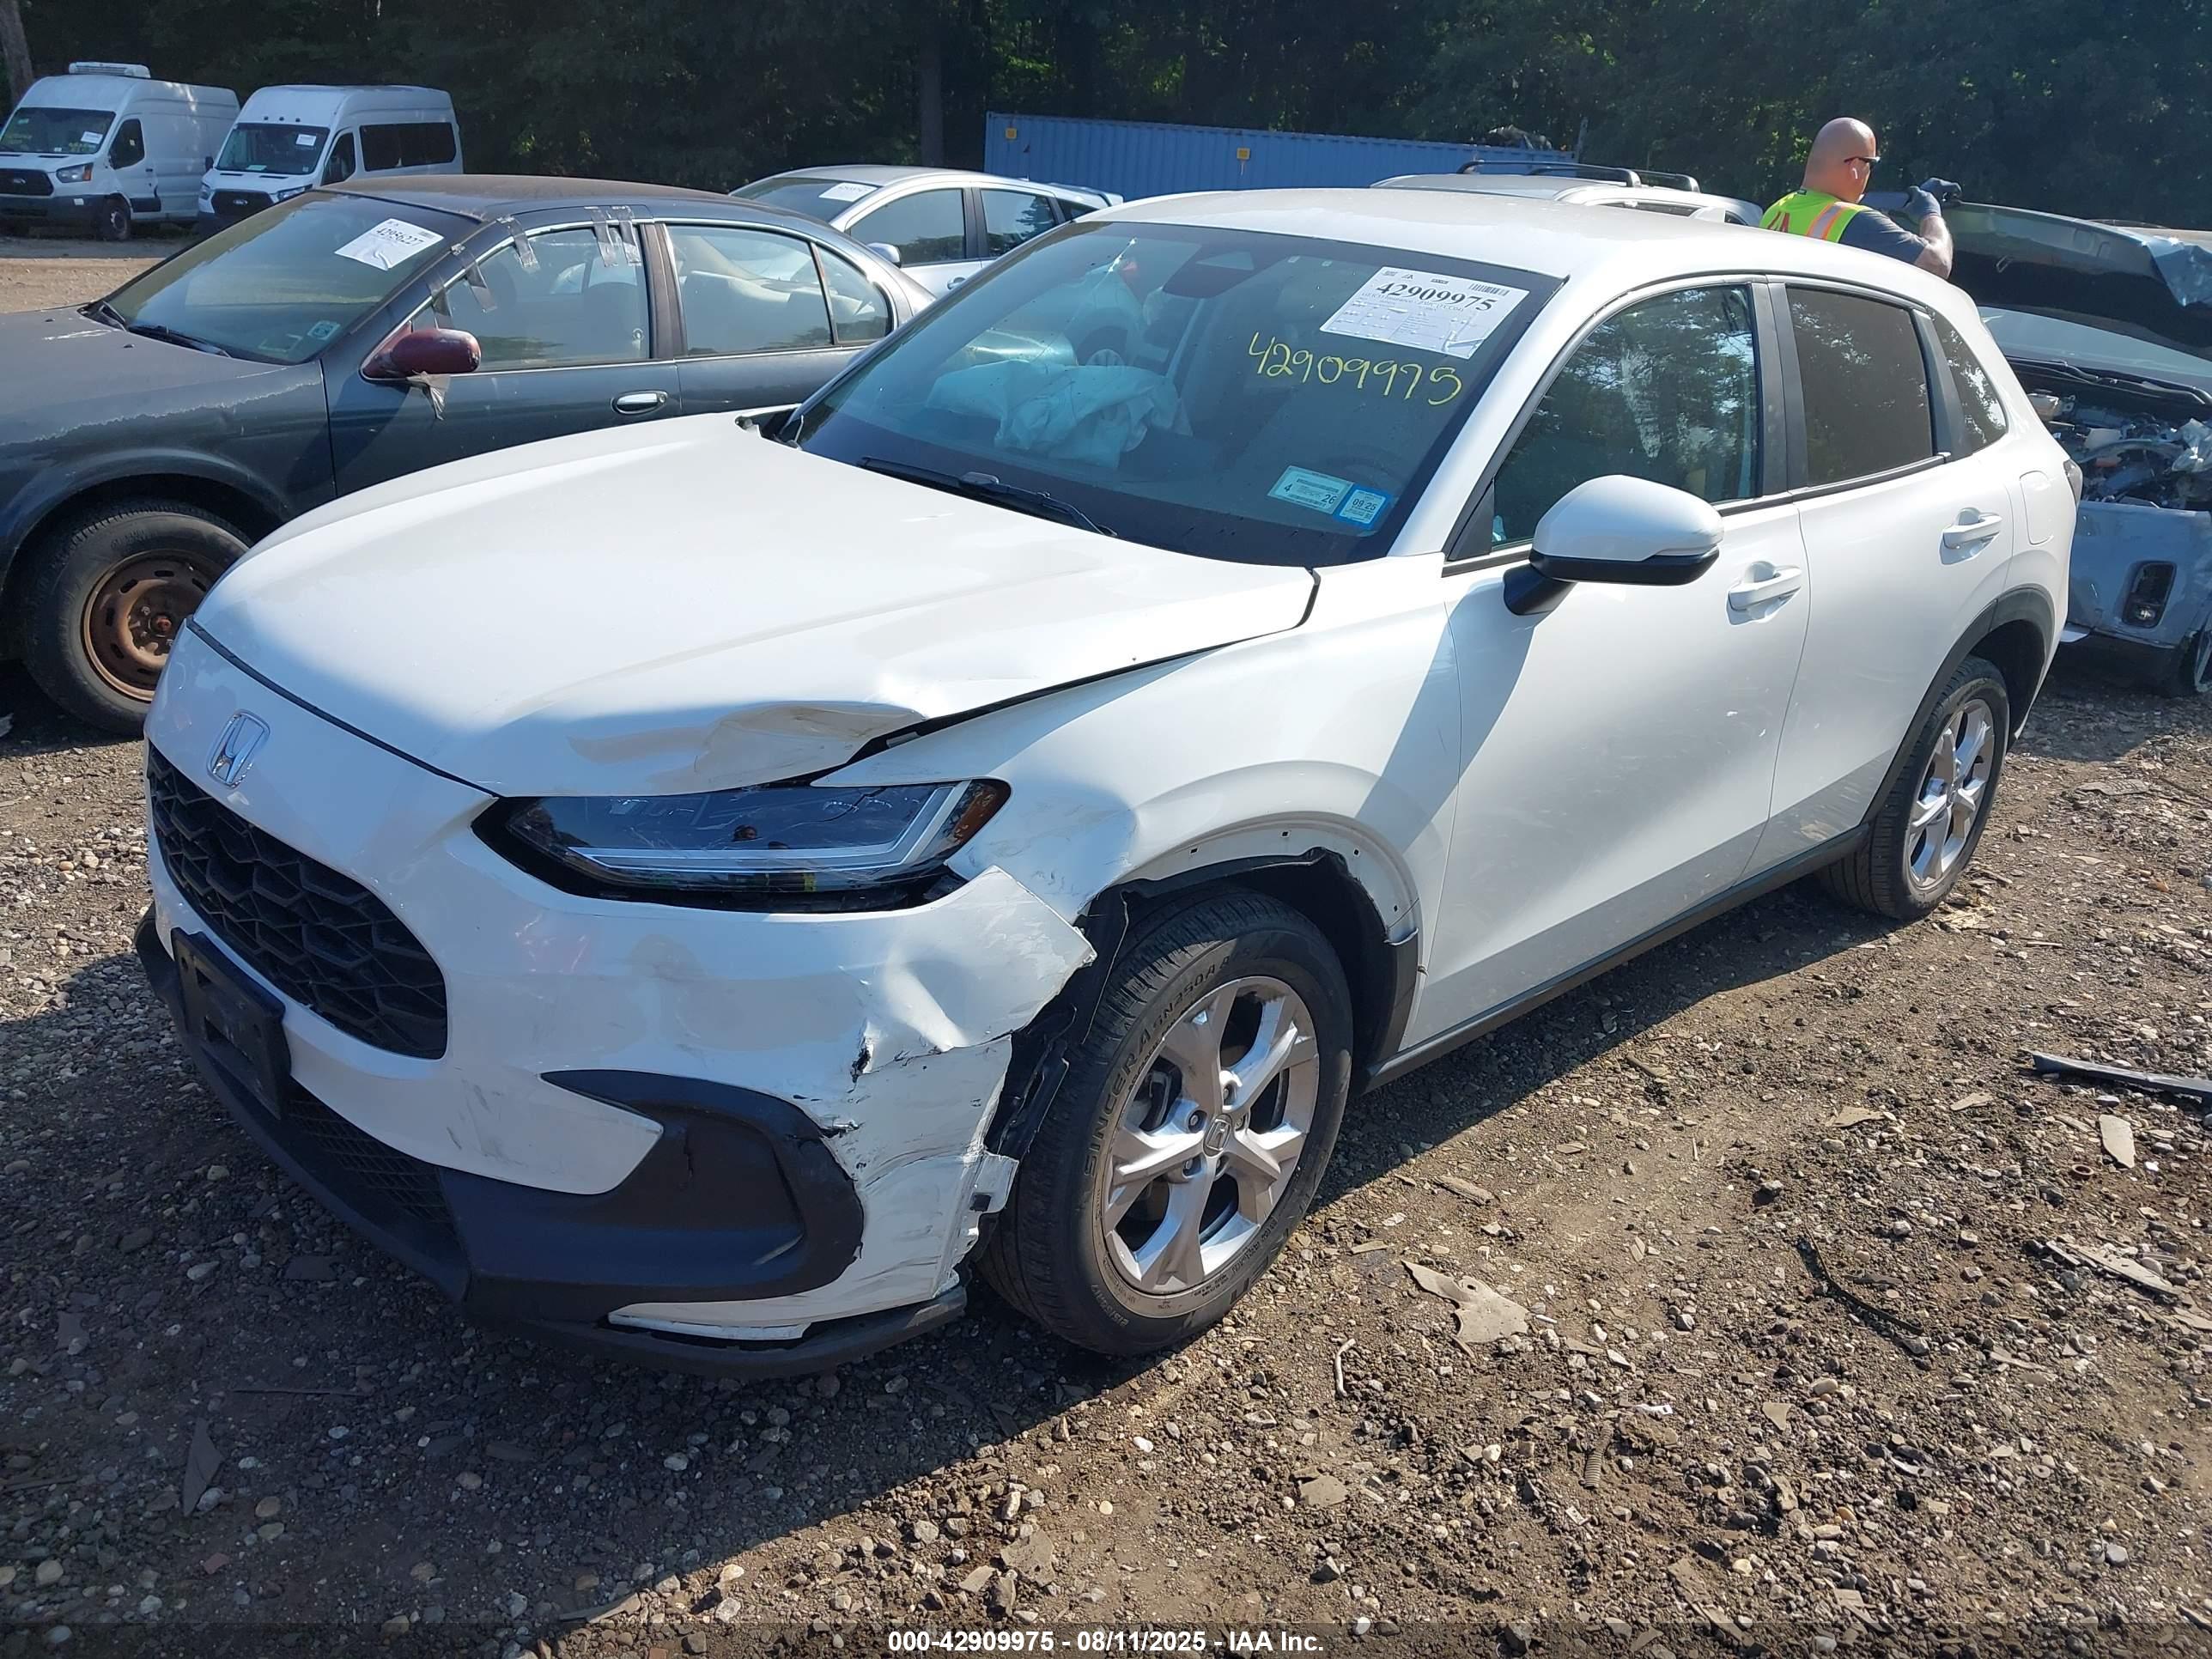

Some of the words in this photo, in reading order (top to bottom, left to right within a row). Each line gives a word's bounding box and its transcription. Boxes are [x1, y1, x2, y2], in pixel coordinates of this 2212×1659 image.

[1376, 282, 1498, 312] 42909975
[1248, 331, 1463, 406] 42909975
[1284, 483, 1292, 493] 4
[1321, 494, 1337, 505] 26
[1084, 1027, 1152, 1176] SINCERA
